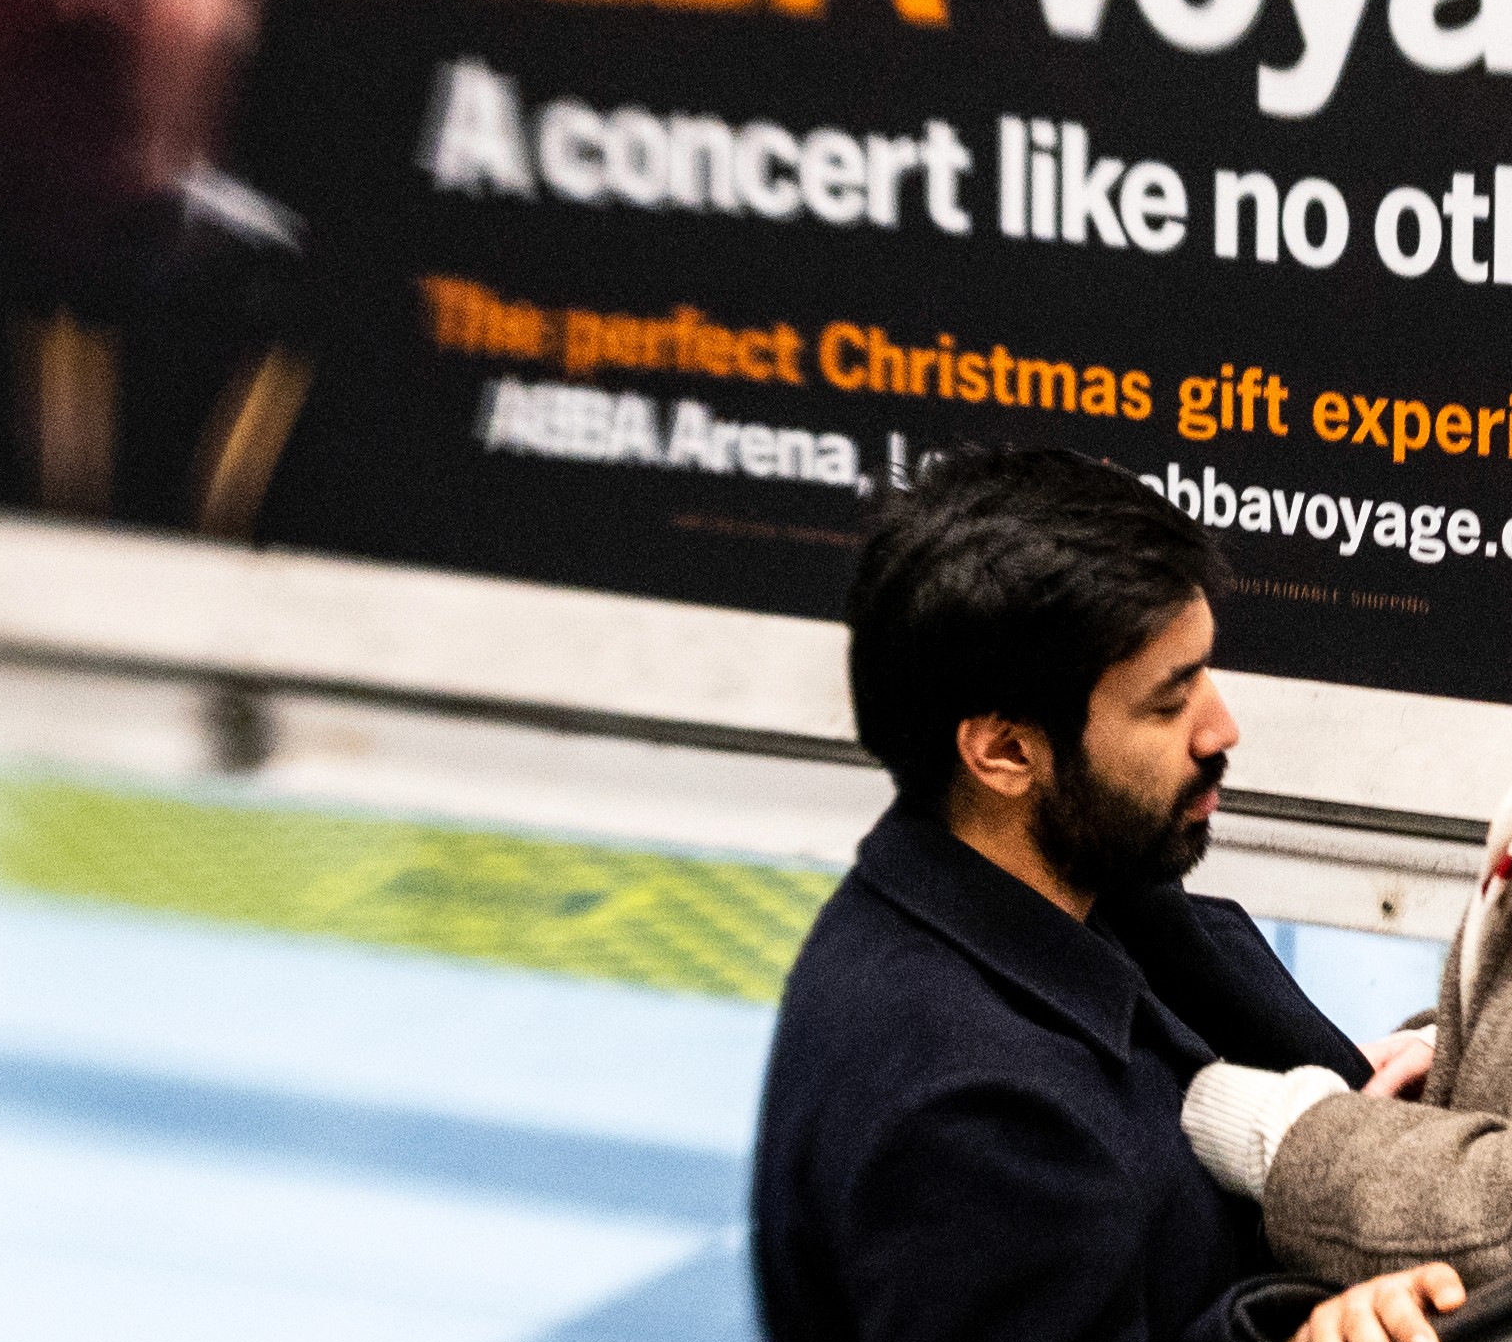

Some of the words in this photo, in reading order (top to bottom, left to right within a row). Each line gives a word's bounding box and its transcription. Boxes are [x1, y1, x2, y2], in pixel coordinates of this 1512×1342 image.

[424, 61, 536, 195] A
[540, 97, 972, 235] concert
[998, 115, 1188, 252] like
[1215, 169, 1349, 269] no
[424, 275, 544, 355] The
[566, 305, 803, 385] perfect
[819, 320, 1152, 421] Christmas
[1178, 363, 1288, 441] gift
[478, 377, 658, 463] ABBA
[667, 399, 872, 496] Arena,
